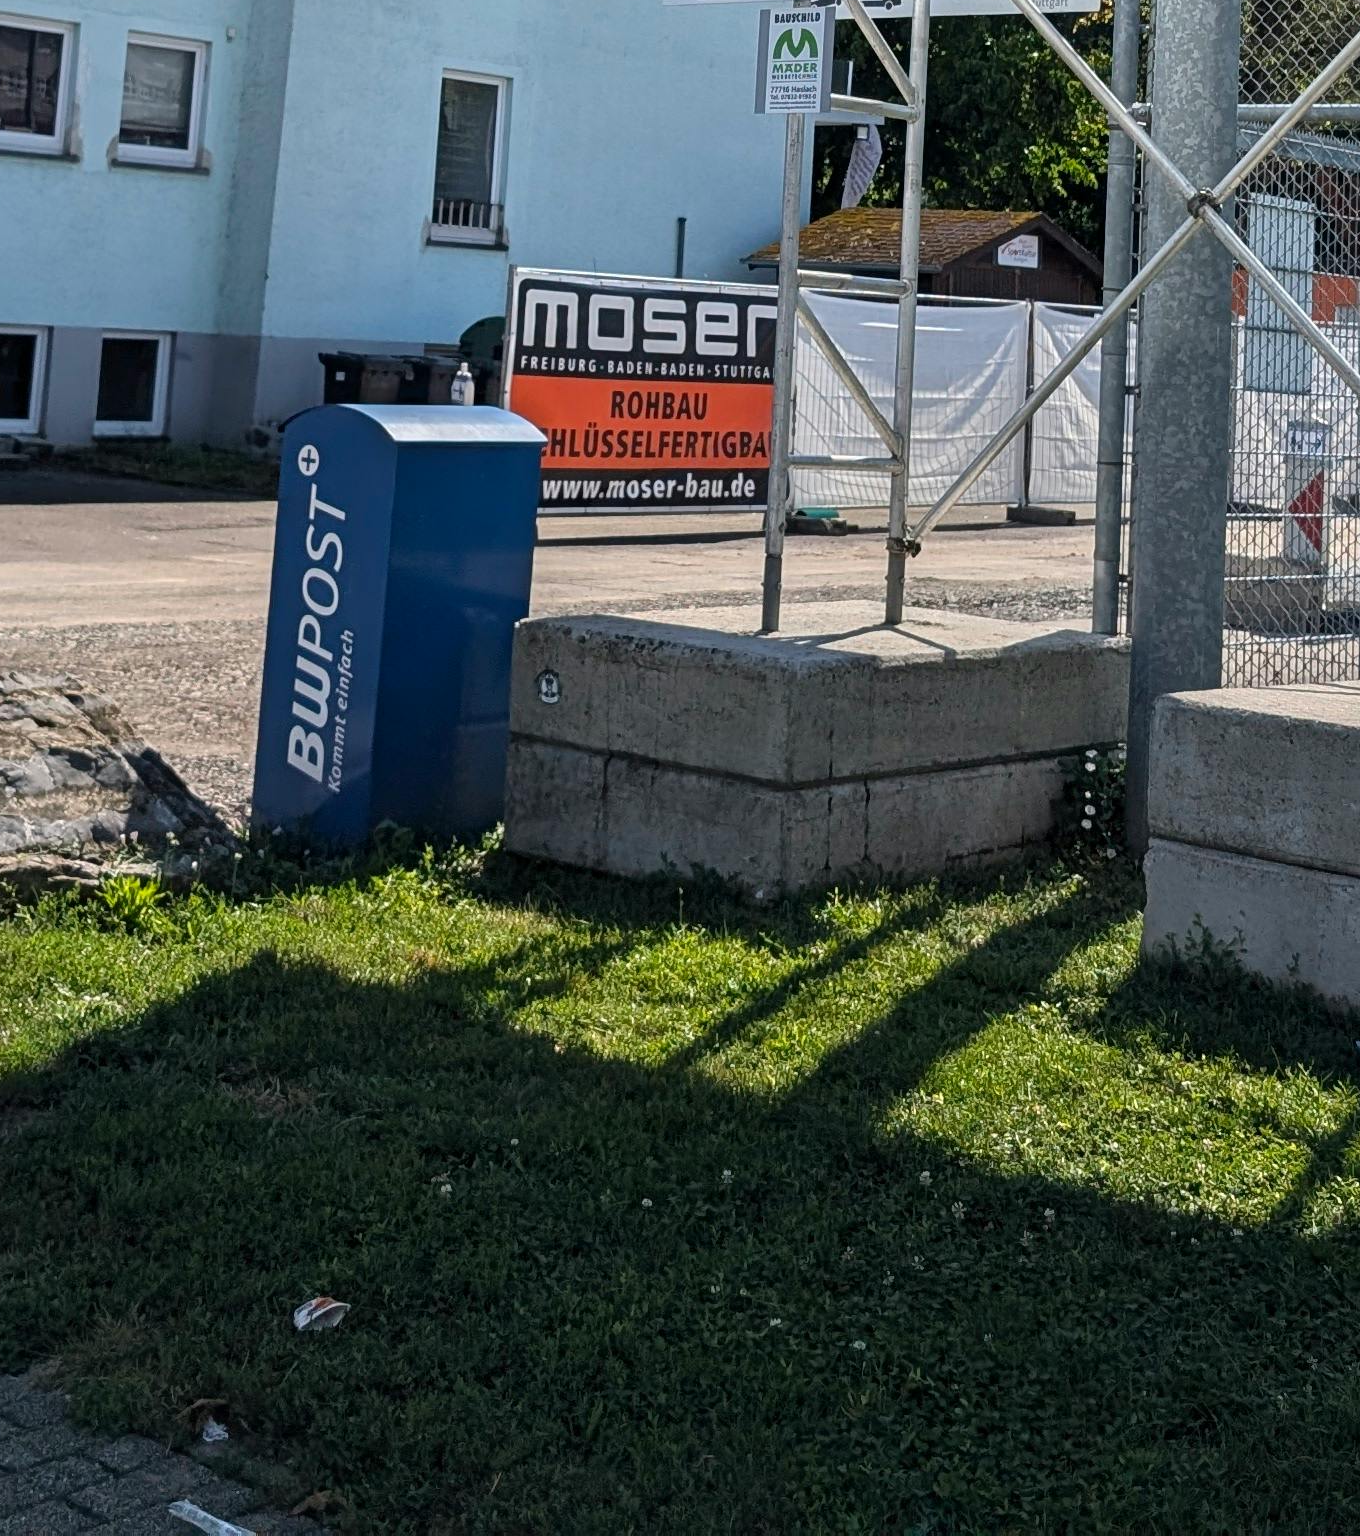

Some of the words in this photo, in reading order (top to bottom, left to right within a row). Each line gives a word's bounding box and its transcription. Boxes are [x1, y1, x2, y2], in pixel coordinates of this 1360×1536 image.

[775, 12, 821, 24] BAUSCHILD
[523, 288, 778, 358] moser
[521, 355, 597, 373] FREIBURG
[714, 366, 776, 380] STUTTGA
[610, 390, 708, 421] ROHBAU
[541, 422, 772, 460] HLÜSSELFERTIGBA
[542, 472, 755, 501] www.moser-bau.de
[336, 628, 355, 711] einfach
[328, 714, 348, 793] Kommt
